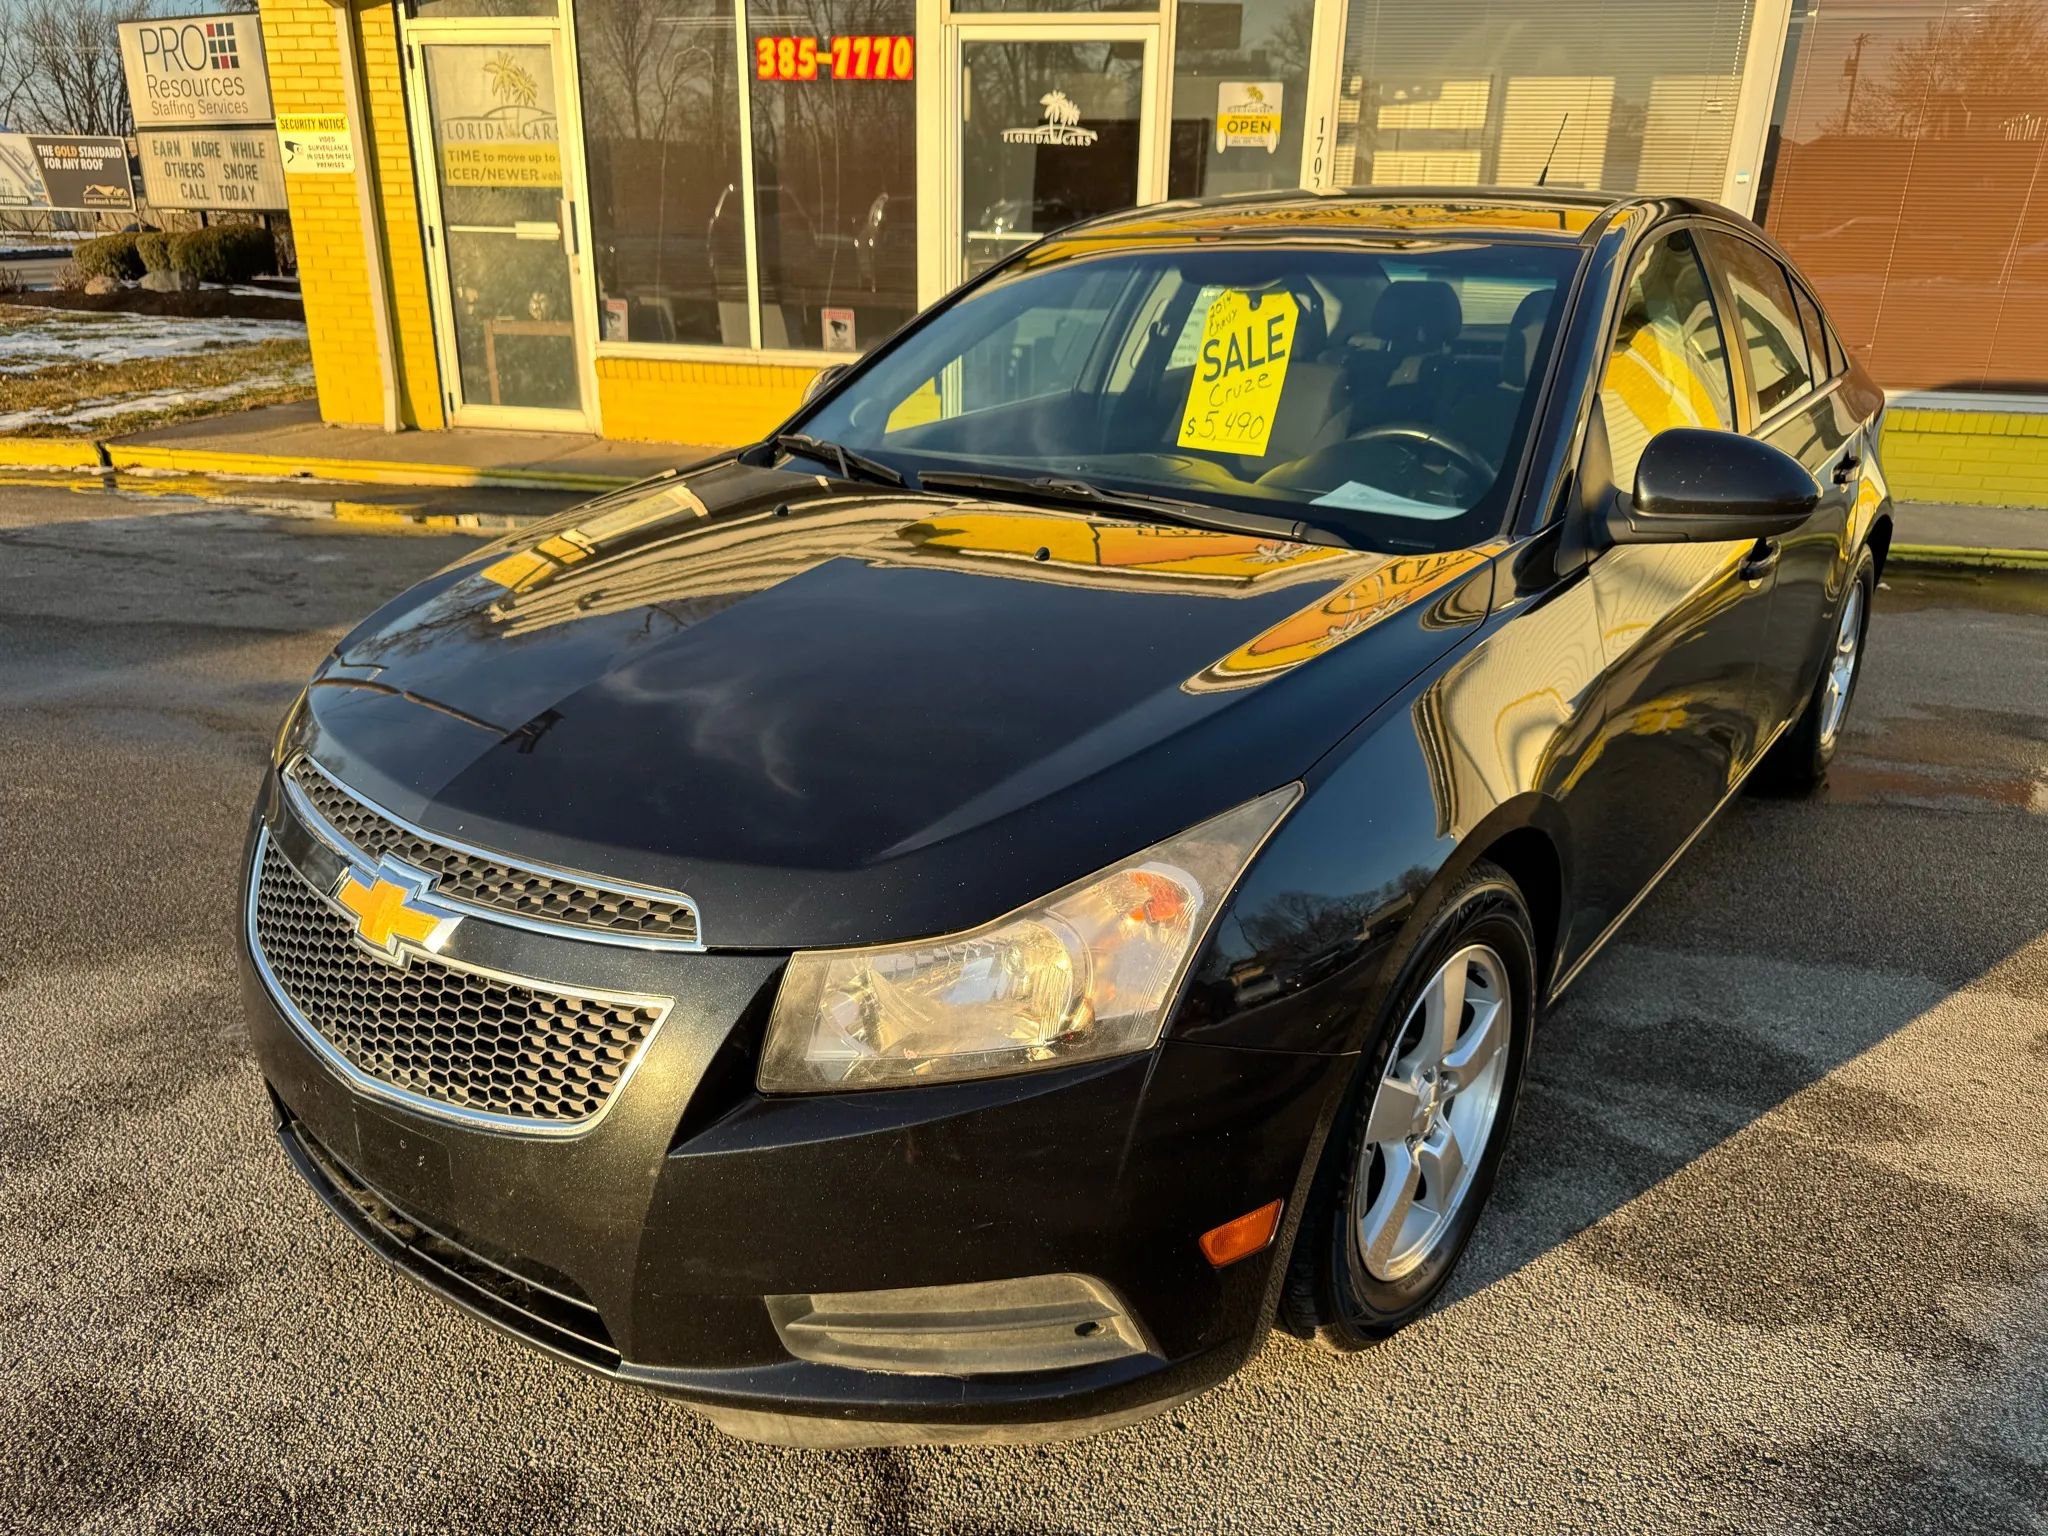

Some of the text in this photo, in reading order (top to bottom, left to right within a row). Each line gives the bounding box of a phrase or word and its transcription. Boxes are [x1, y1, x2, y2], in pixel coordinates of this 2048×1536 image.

[139, 24, 206, 73] PRO
[757, 36, 912, 79] 385-7770
[146, 74, 245, 99] Resources
[151, 99, 249, 118] Staffing Services
[280, 118, 346, 130] SECURITY NOTICE
[440, 121, 505, 140] LORIDA
[1227, 120, 1271, 134] OPEN
[1003, 131, 1092, 147] FLORIDA CARS
[37, 144, 122, 158] THE GOLD STANDARD
[152, 140, 266, 159] EARN MORE WHILE
[447, 150, 556, 165] TIME to move up to
[44, 158, 104, 171] FOR ANY ROOF
[164, 161, 259, 180] OTHERS SNORE
[445, 167, 539, 182] ICER/NEWER
[180, 183, 256, 202] CALL TODAY
[1209, 294, 1232, 319] 2014
[1202, 313, 1286, 383] SALE
[1209, 373, 1272, 407] Cruze
